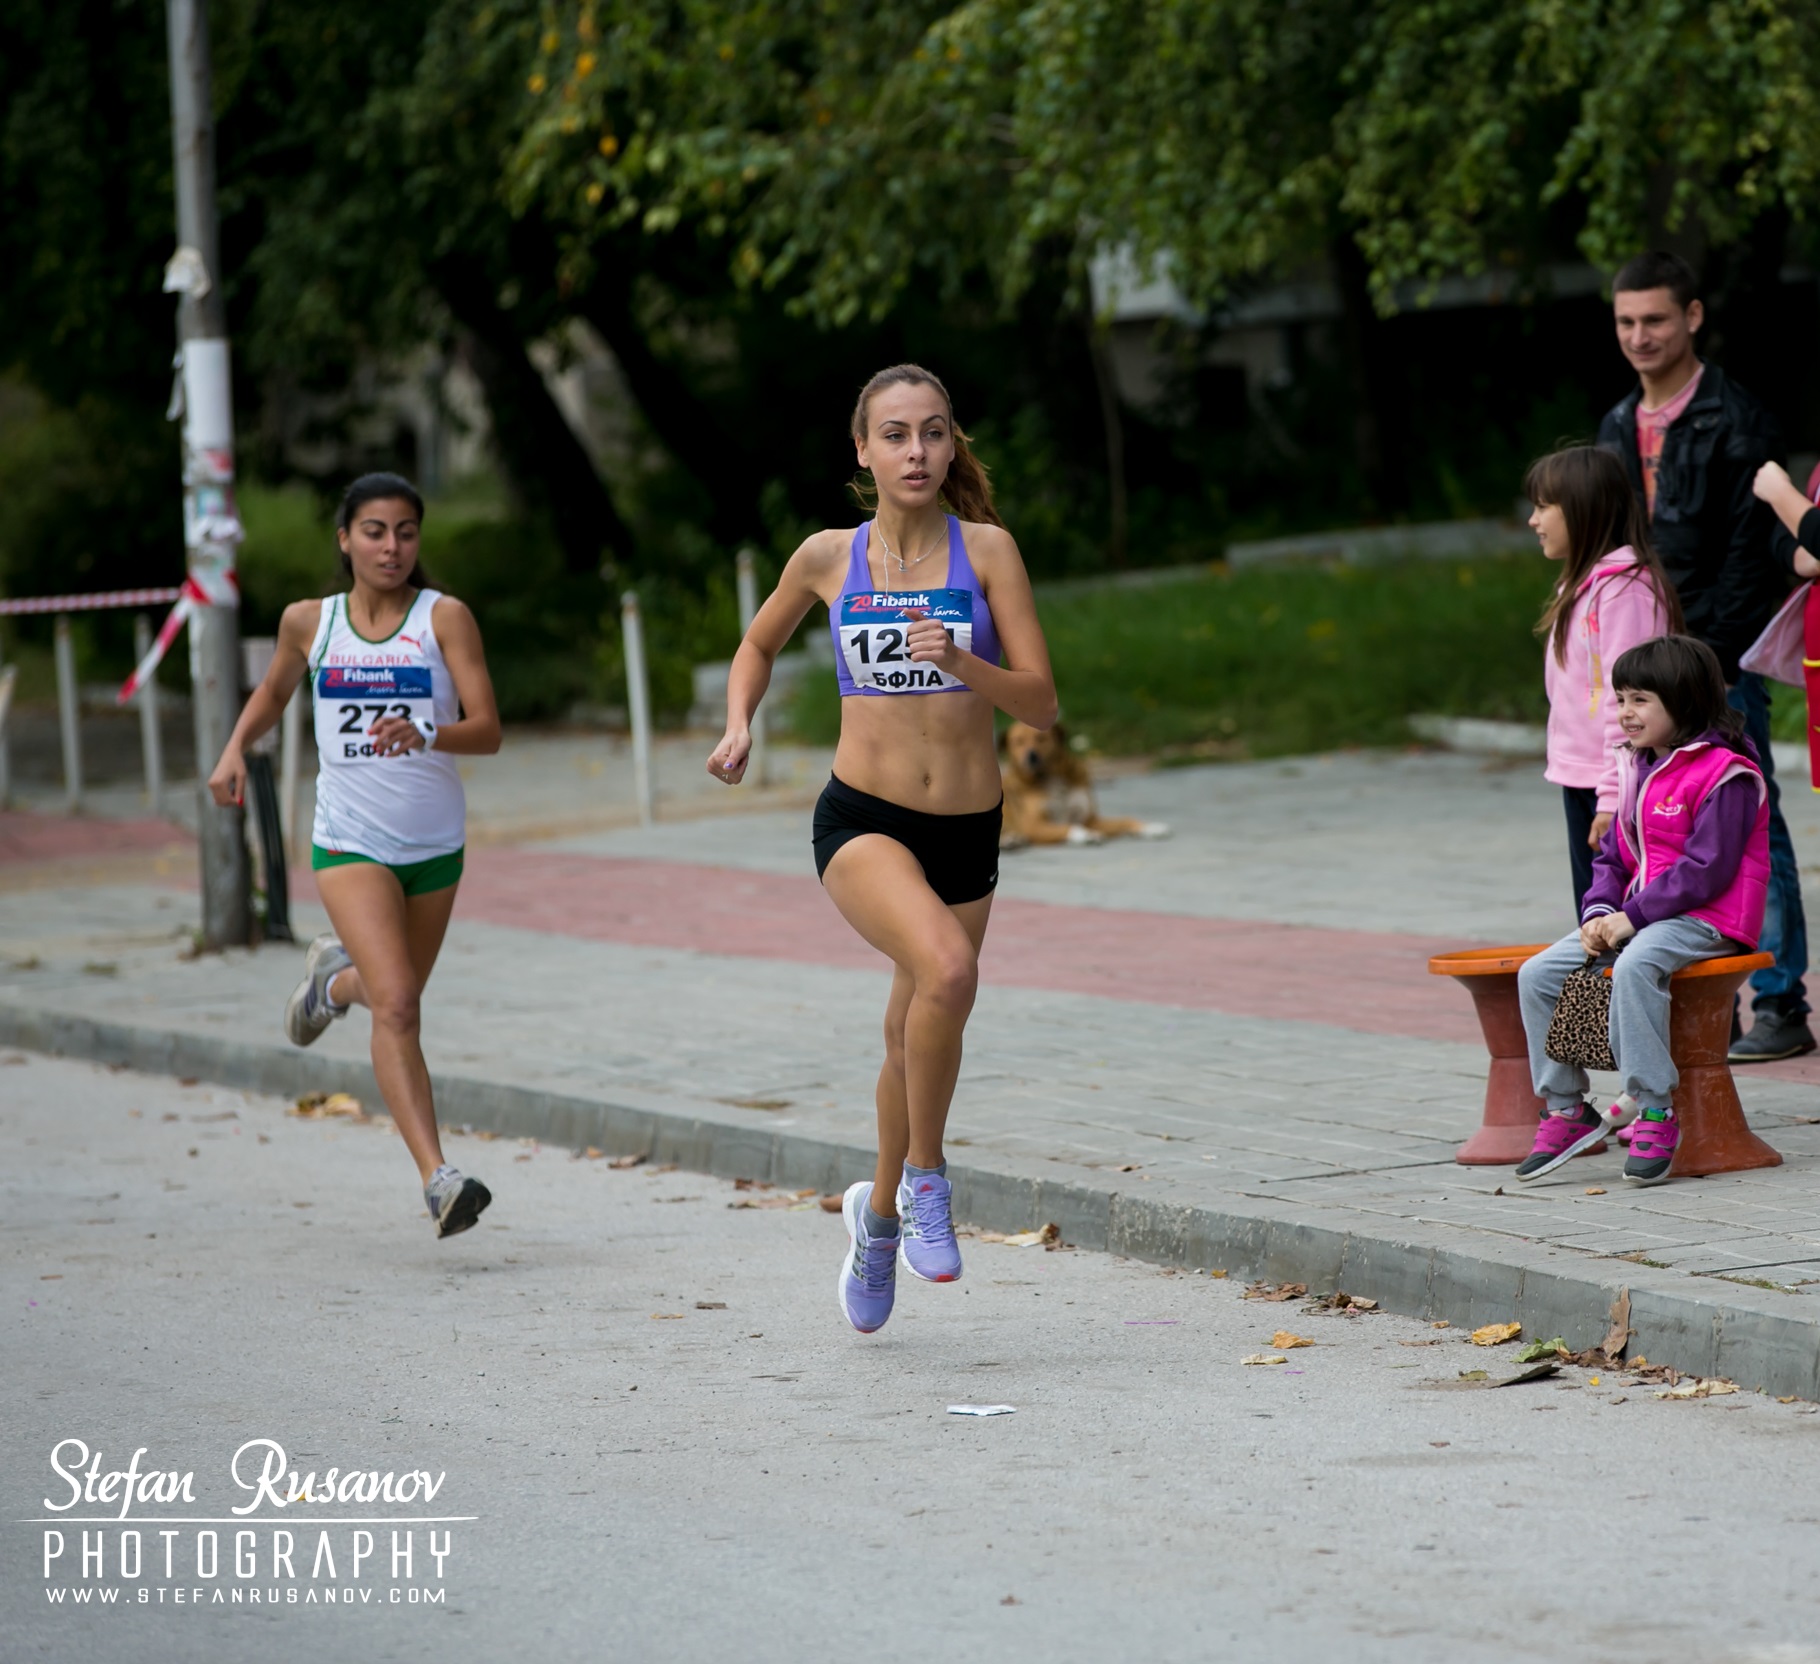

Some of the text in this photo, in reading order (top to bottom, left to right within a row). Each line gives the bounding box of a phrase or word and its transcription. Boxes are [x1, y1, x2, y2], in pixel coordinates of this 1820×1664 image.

[872, 594, 929, 606] Fibank
[329, 655, 412, 666] BULGARIA
[343, 668, 394, 682] Fibank
[872, 670, 944, 688] БФЛА
